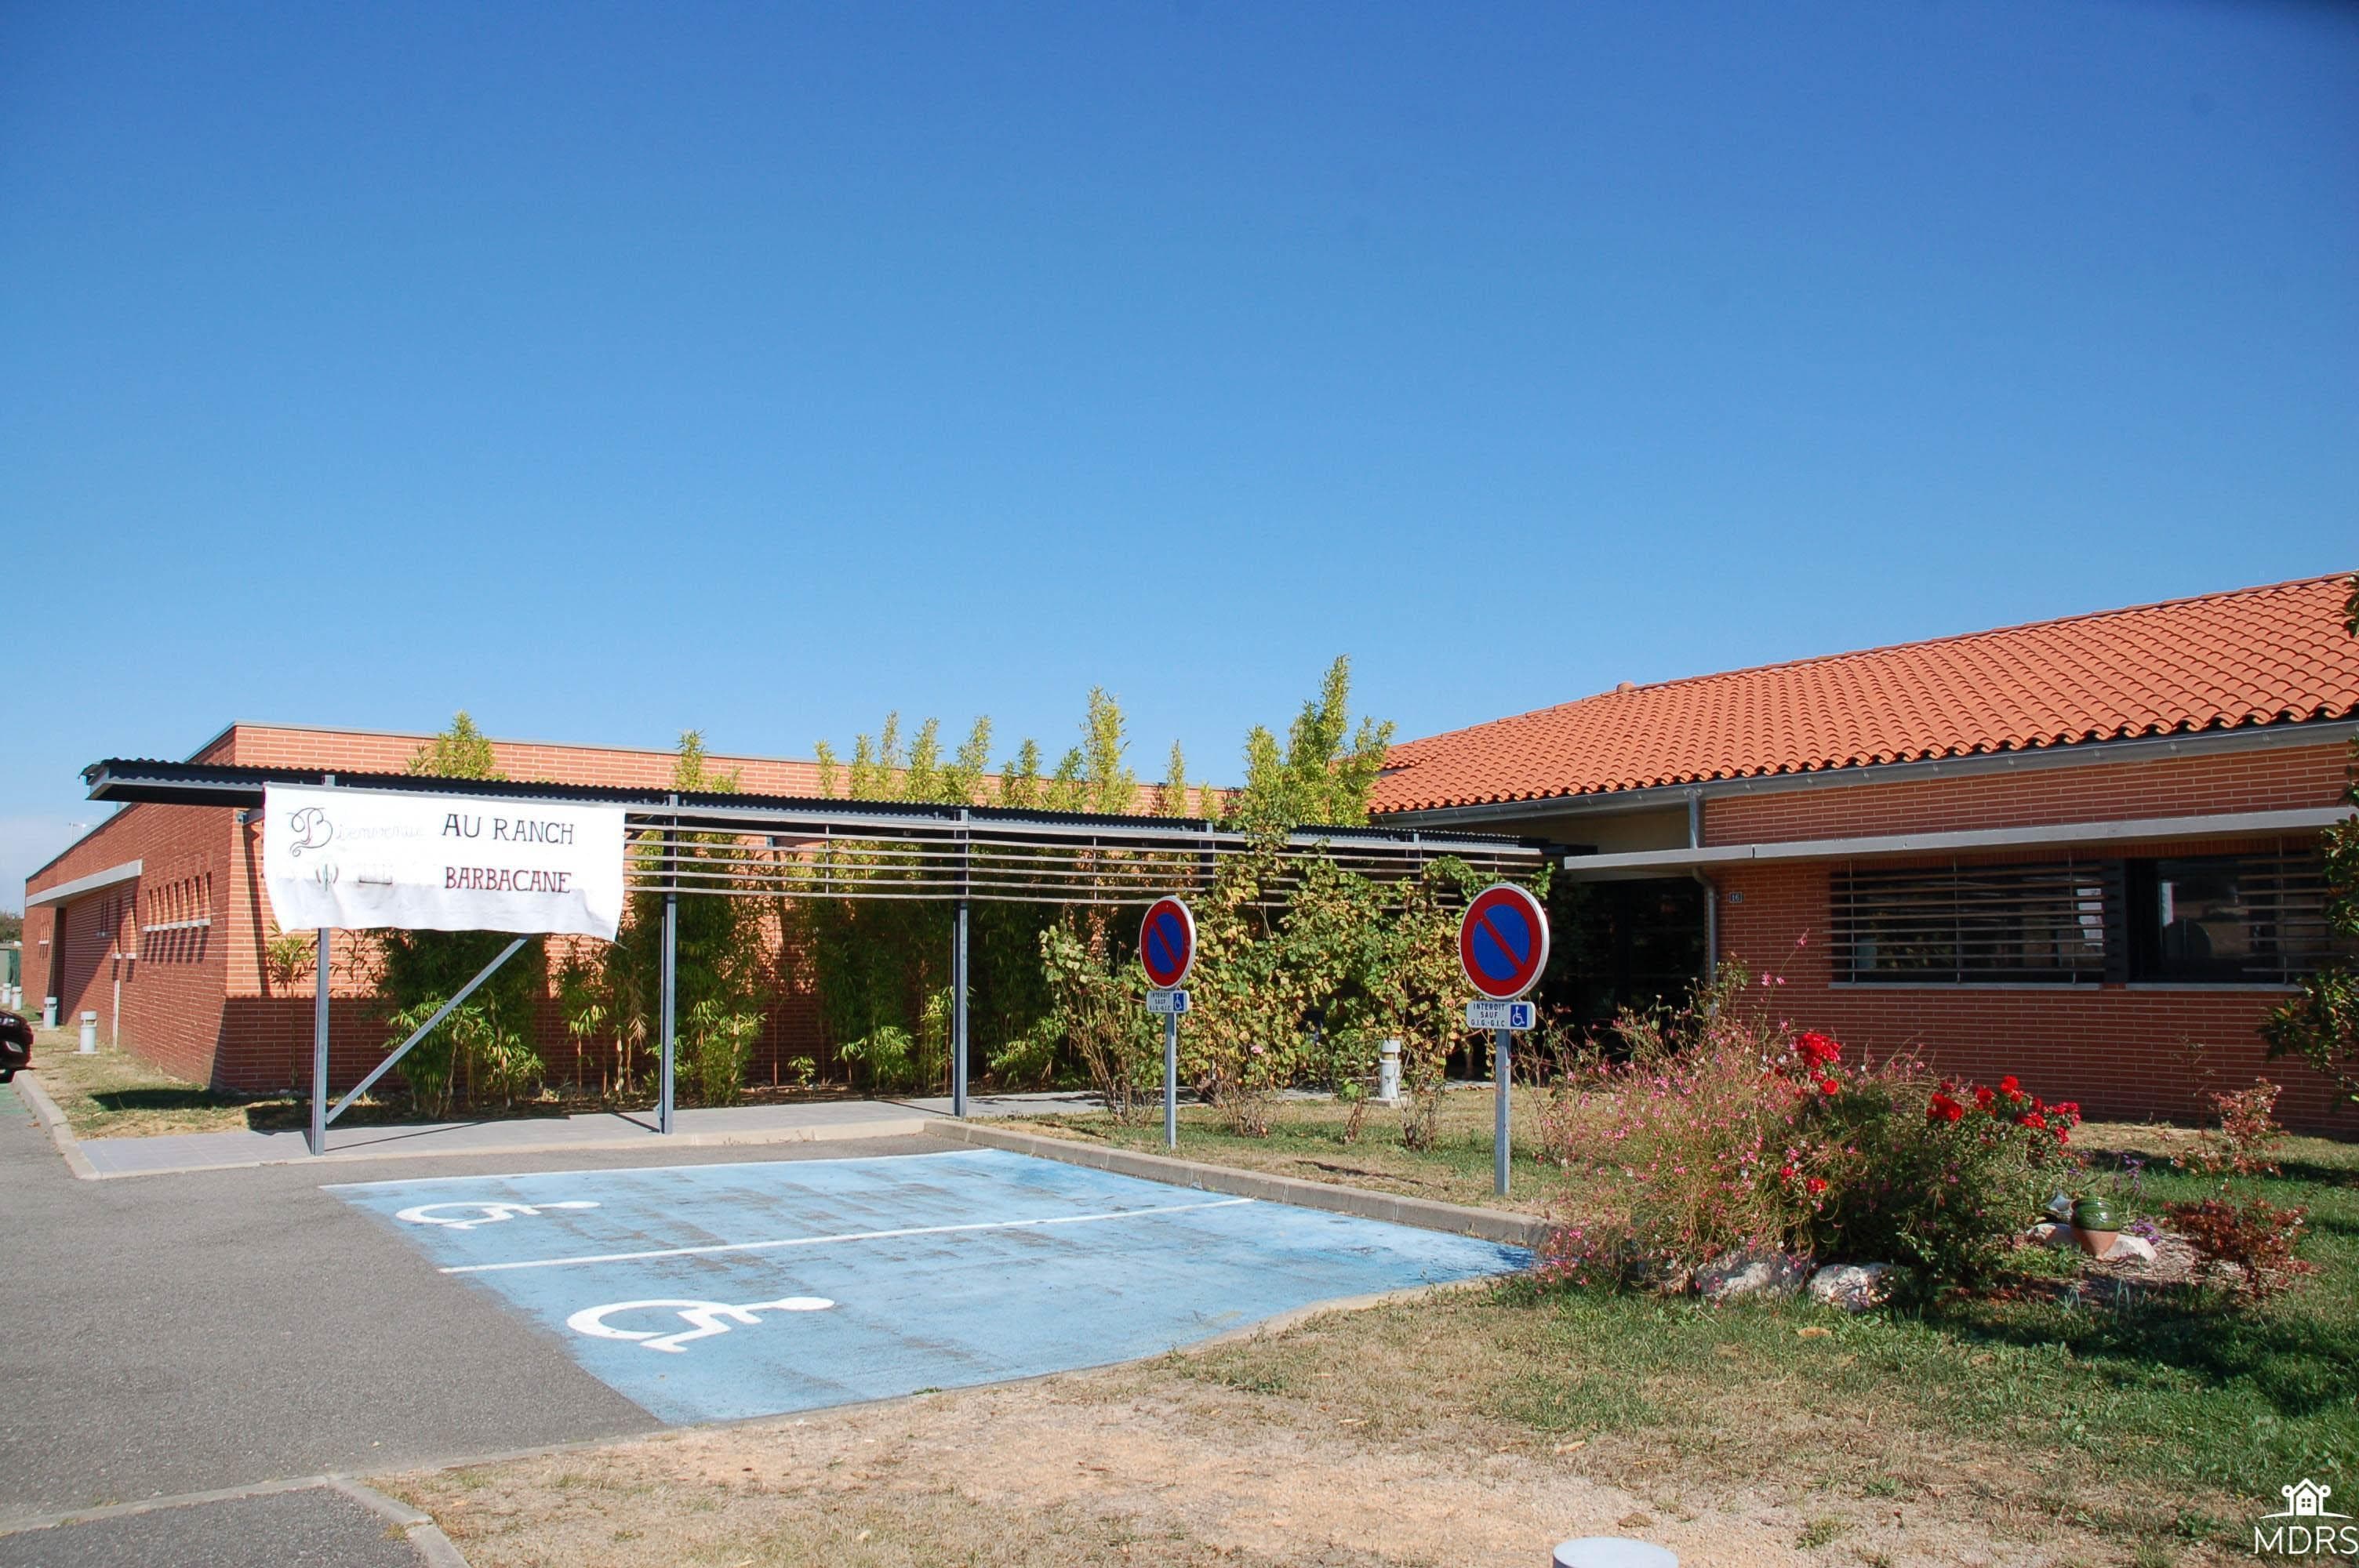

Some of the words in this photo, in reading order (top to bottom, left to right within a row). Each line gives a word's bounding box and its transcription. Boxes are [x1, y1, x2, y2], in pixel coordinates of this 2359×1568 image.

[442, 813, 481, 838] AU
[493, 818, 575, 845] RANCH
[445, 866, 572, 894] BARBACANE
